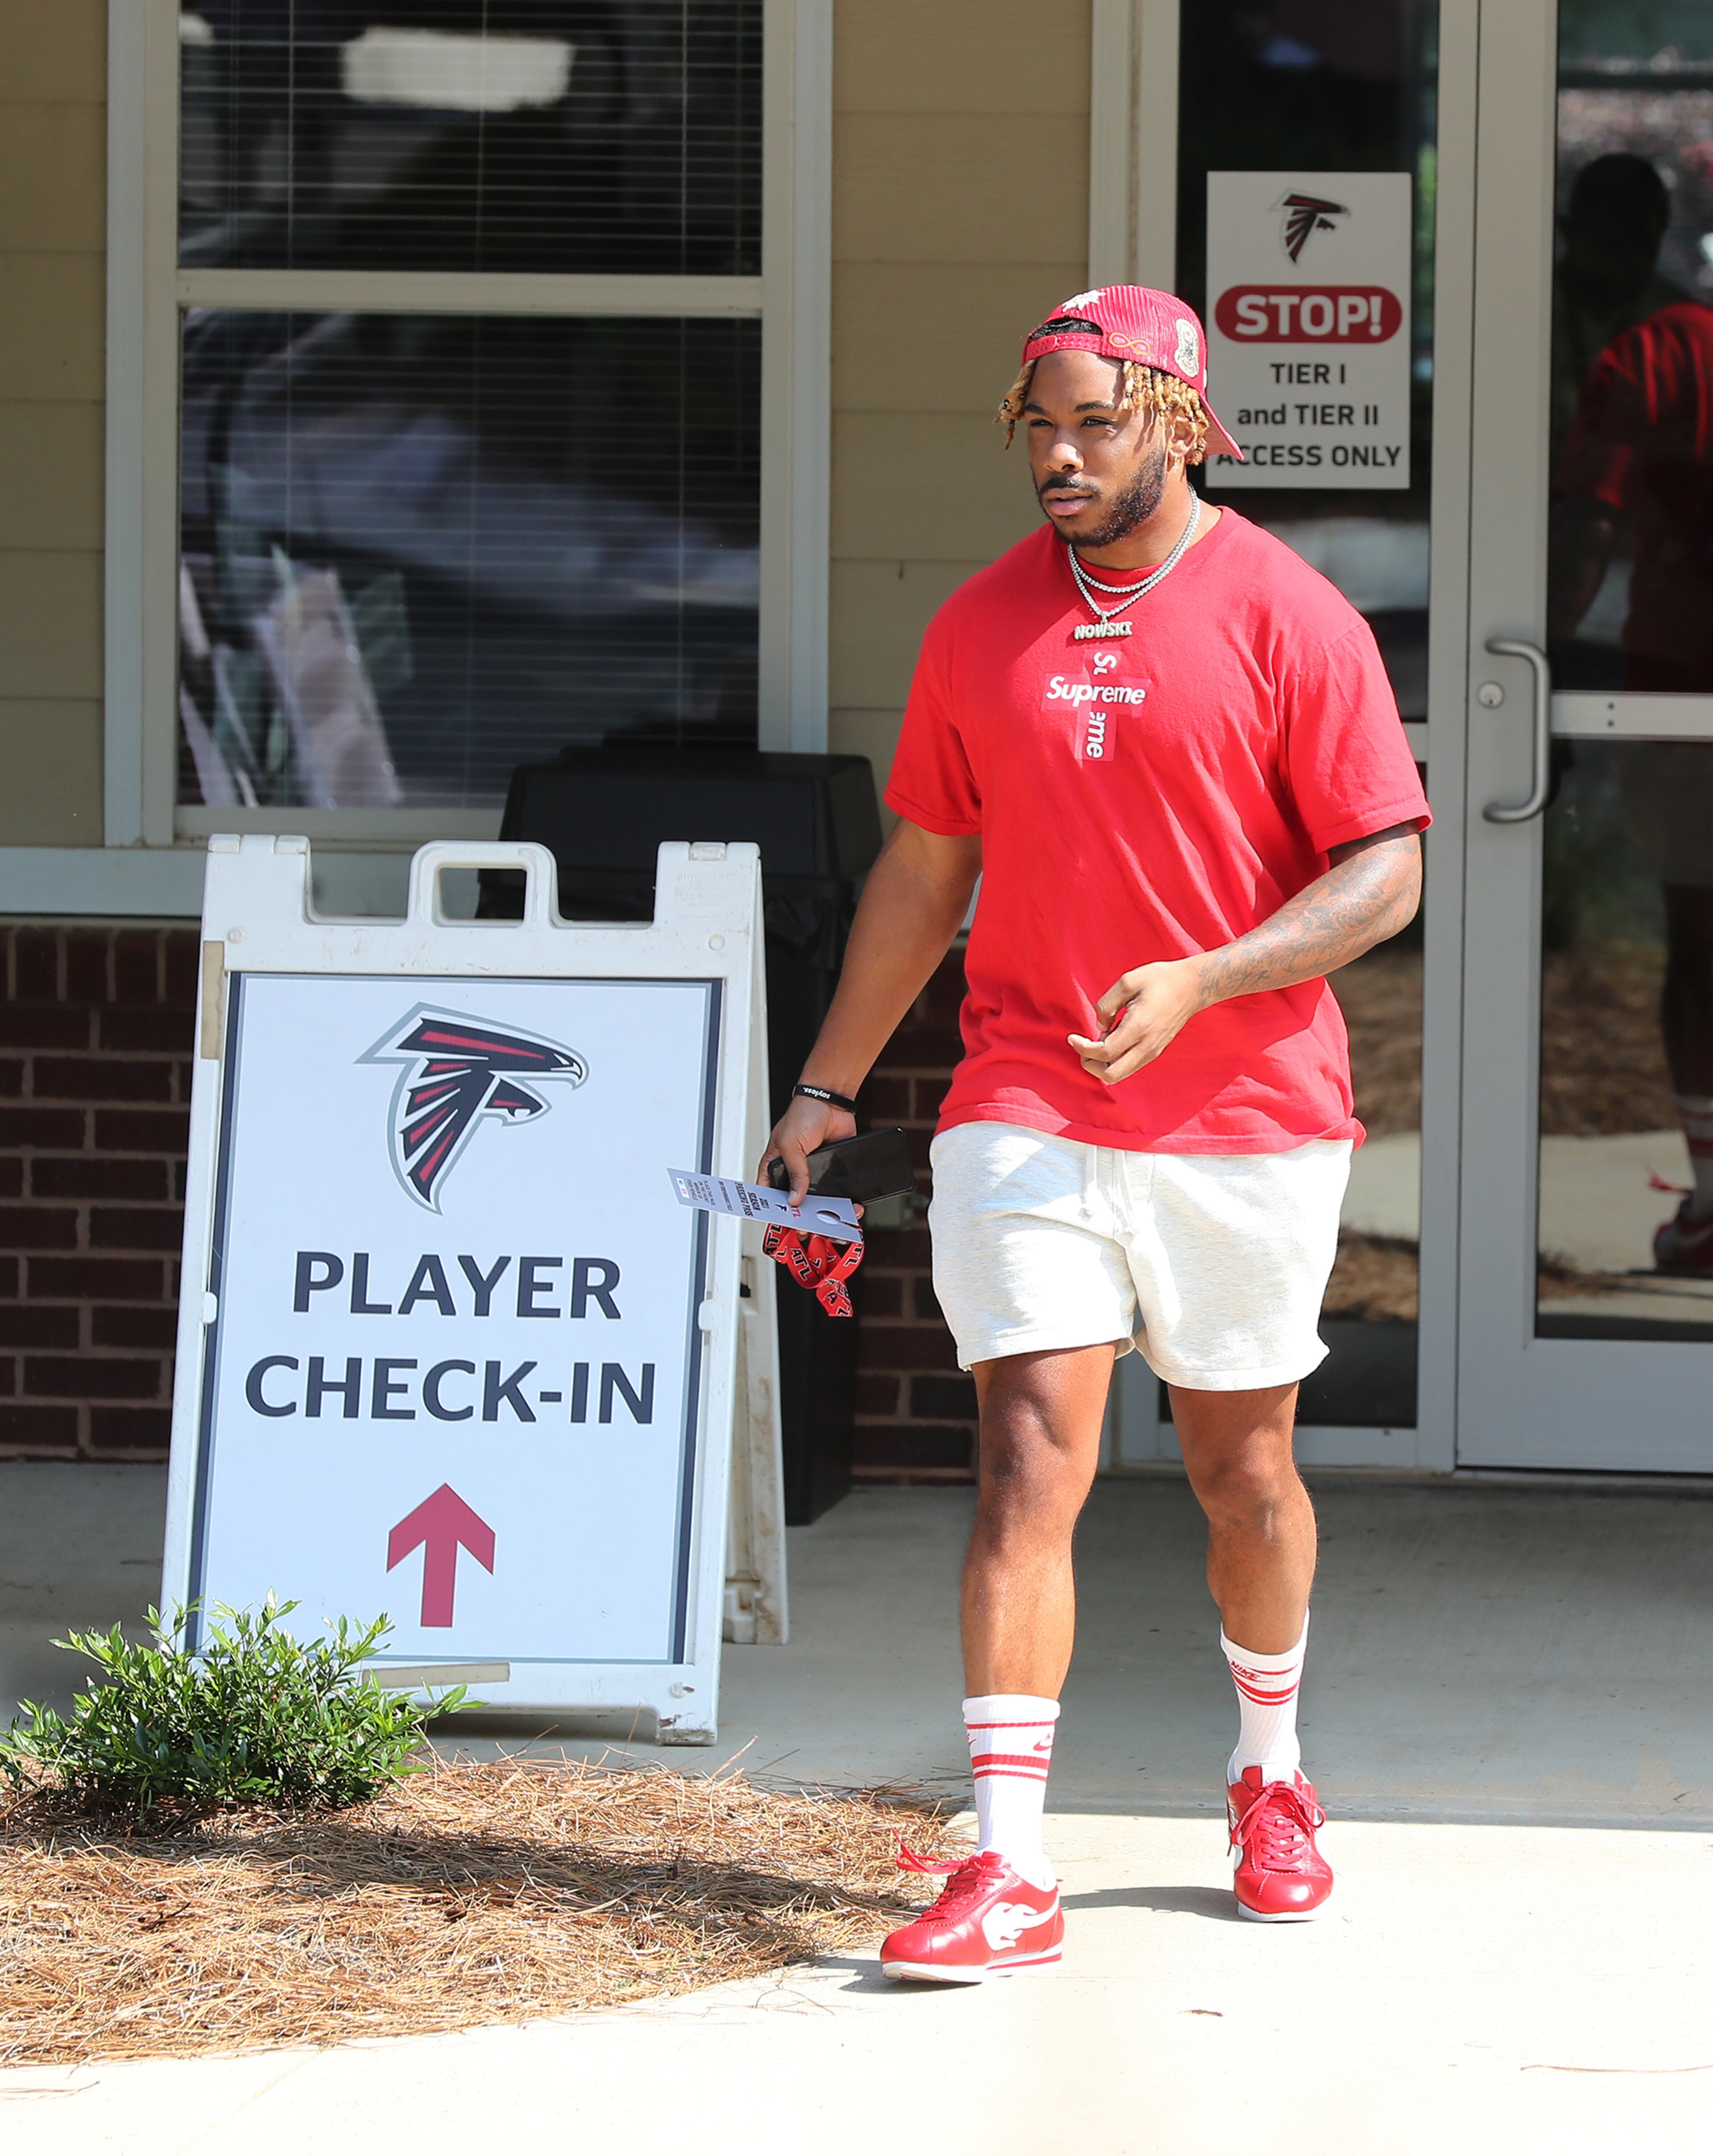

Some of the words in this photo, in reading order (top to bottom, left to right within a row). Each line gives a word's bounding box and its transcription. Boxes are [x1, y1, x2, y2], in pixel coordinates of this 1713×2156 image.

[1235, 294, 1382, 336] STOP!
[1271, 364, 1329, 383] TIER
[1341, 364, 1345, 383] I
[1238, 404, 1286, 425] and
[1295, 406, 1353, 425] TIER
[1365, 406, 1378, 425] II
[1216, 446, 1321, 466] ACCESS
[1332, 446, 1400, 466] ONLY
[1074, 621, 1133, 640] NOWSKI
[1046, 676, 1146, 707] Supreme
[790, 1248, 811, 1281] ATL
[293, 1251, 621, 1319] PLAYER
[245, 1355, 655, 1424] CHECK-IN
[1230, 1659, 1260, 1681] NIKE
